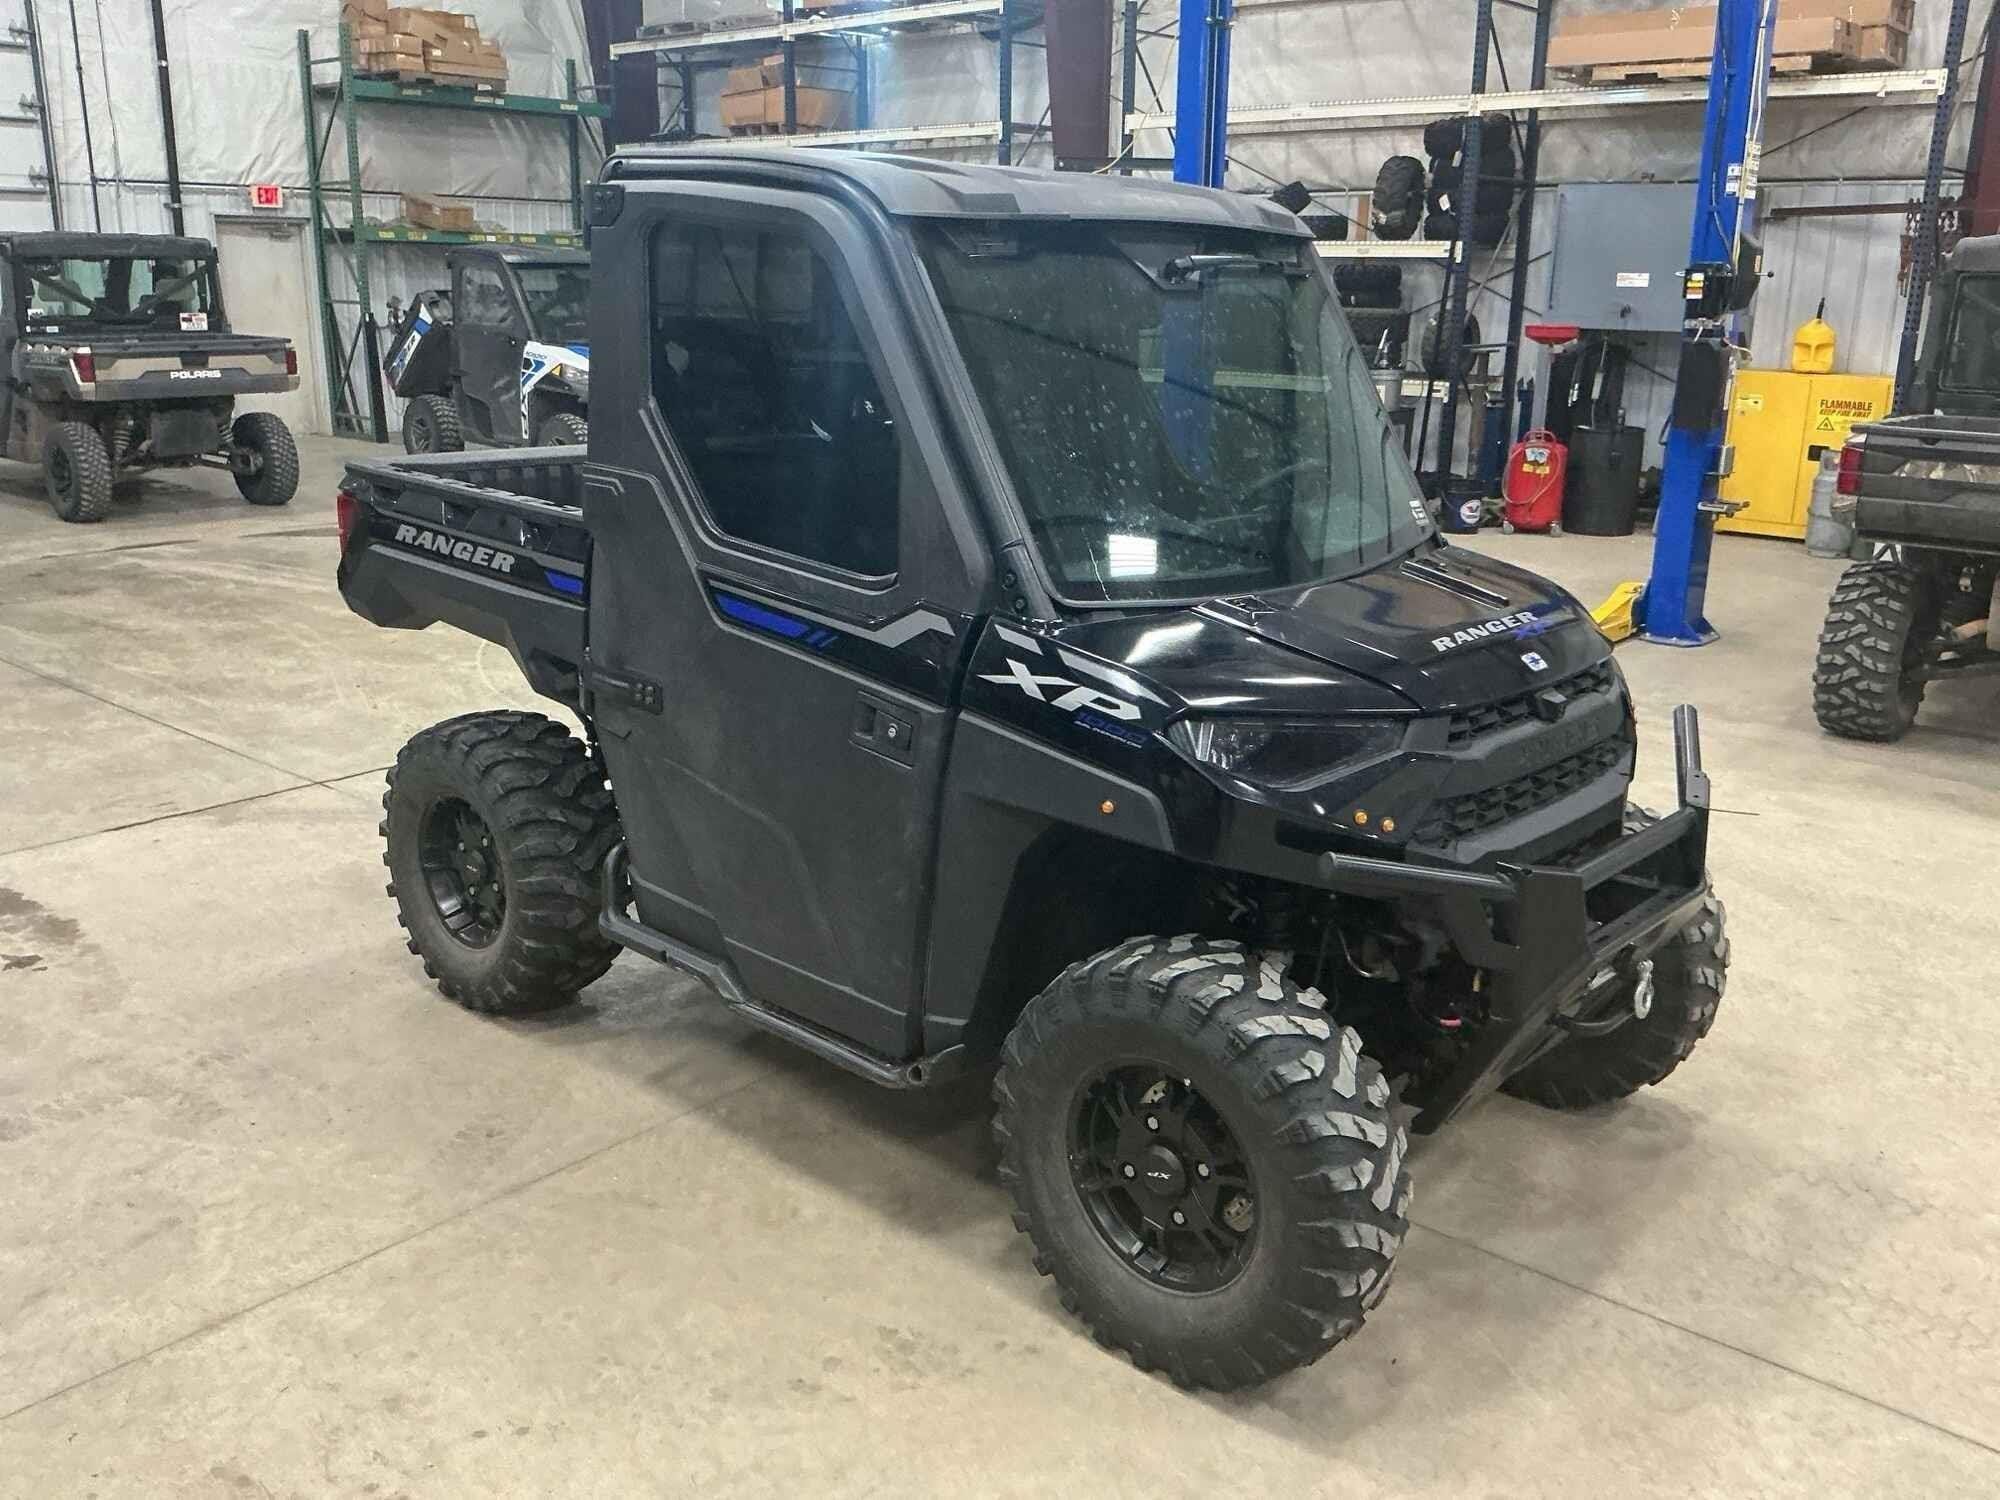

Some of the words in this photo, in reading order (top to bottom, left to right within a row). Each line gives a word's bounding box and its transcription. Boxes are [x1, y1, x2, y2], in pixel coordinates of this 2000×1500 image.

[258, 187, 279, 204] EXIT
[170, 370, 222, 379] POLARIS
[1820, 399, 1872, 411] FLAMMABLE
[395, 523, 515, 573] RANGER
[1431, 611, 1539, 652] RANGER
[976, 657, 1142, 720] XP
